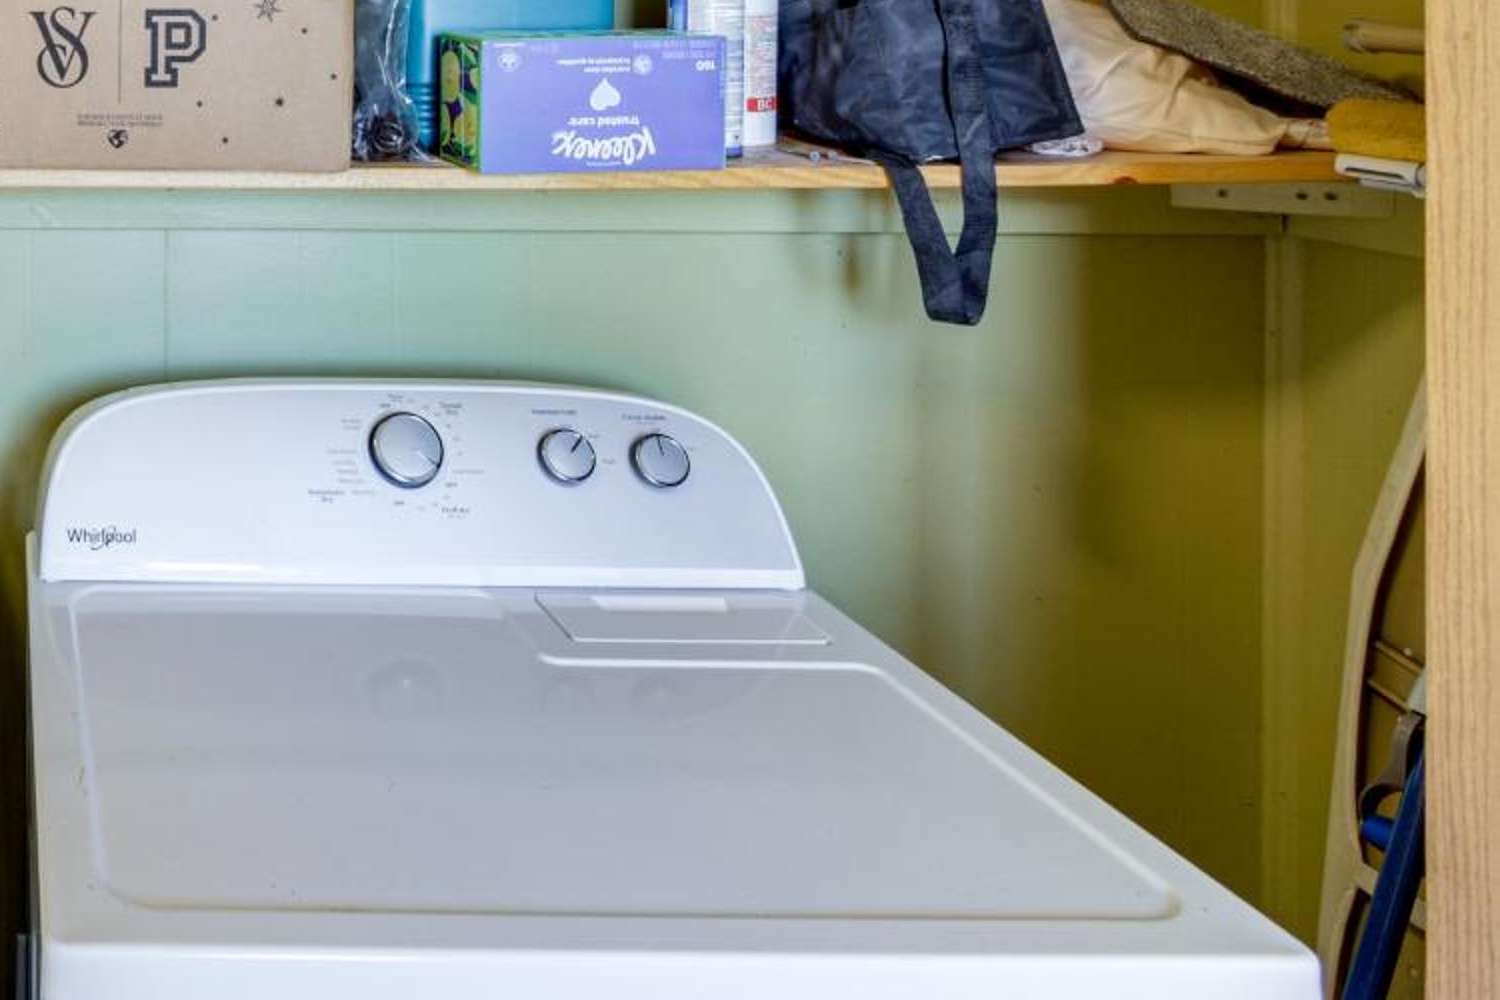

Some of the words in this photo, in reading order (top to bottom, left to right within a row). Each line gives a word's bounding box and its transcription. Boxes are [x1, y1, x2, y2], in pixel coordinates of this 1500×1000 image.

[144, 8, 207, 88] P
[598, 115, 640, 128] trusted
[550, 126, 657, 166] Kleenex
[67, 525, 137, 551] Whirlpool
